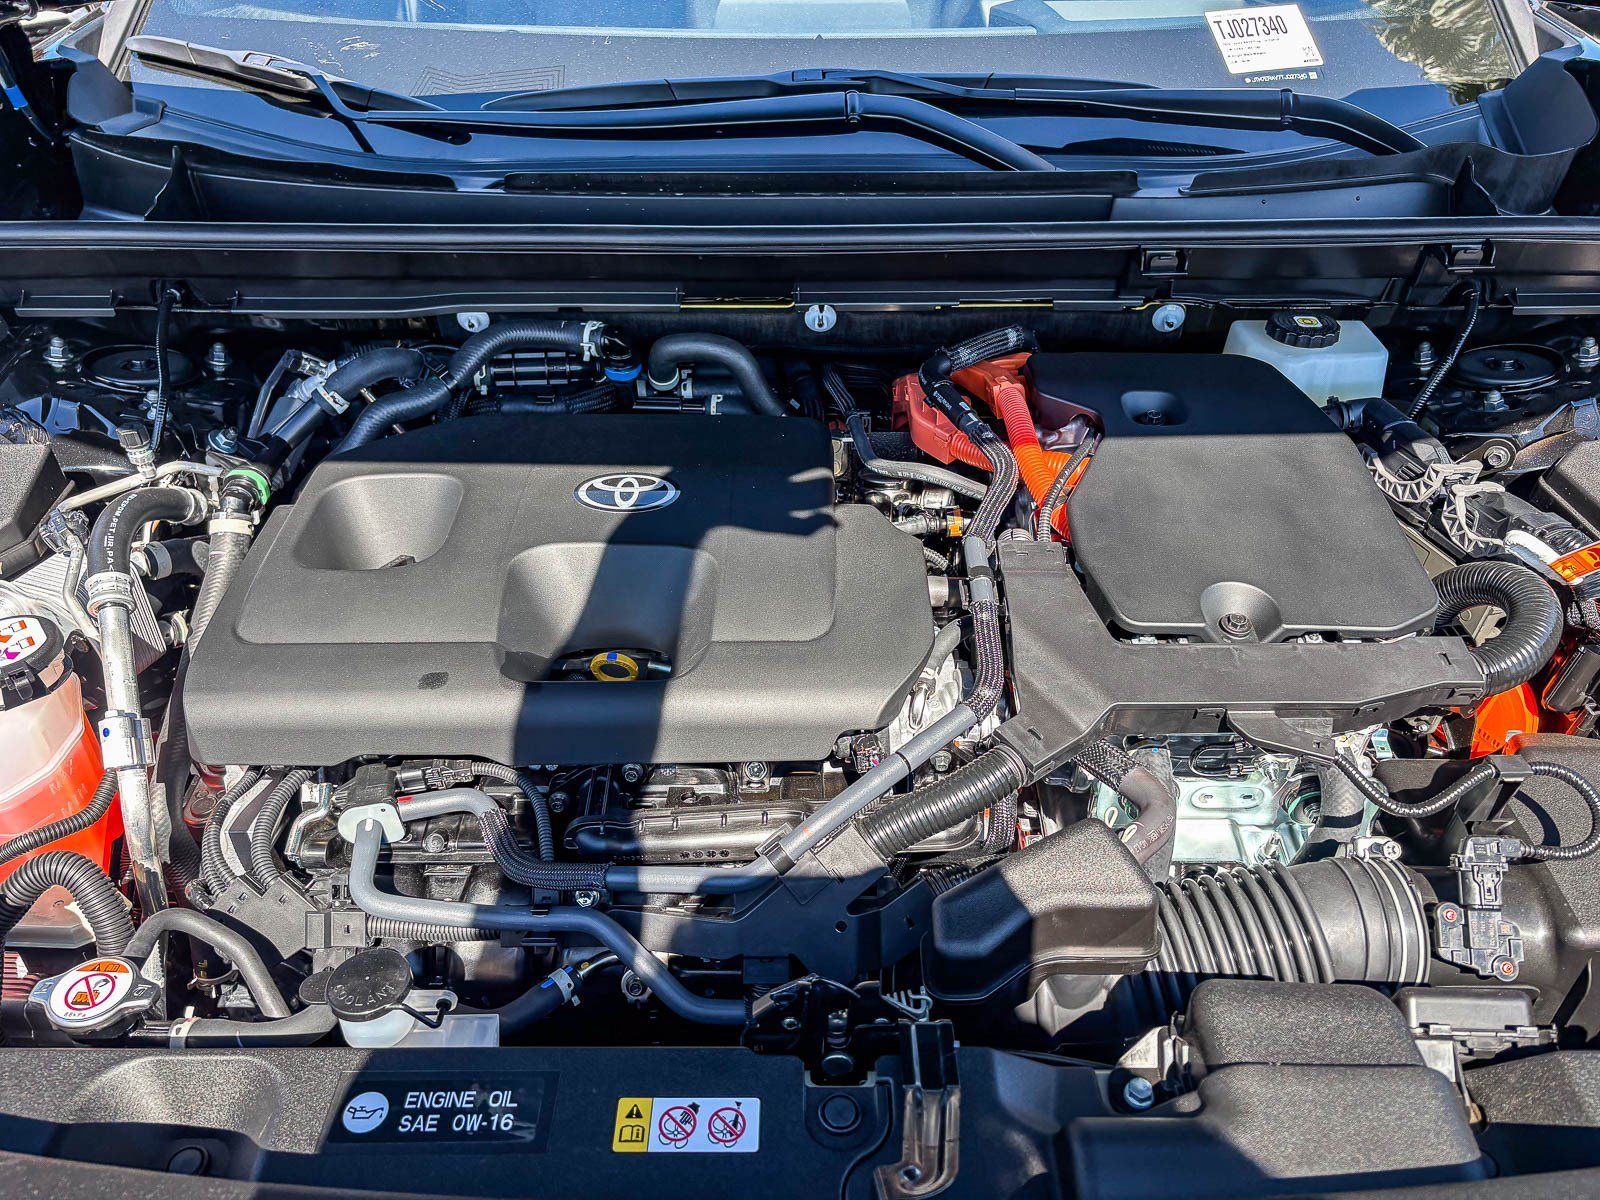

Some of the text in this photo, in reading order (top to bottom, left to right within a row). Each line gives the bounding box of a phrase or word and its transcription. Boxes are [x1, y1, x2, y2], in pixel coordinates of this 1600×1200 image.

[1213, 15, 1288, 40] TJ027340
[334, 984, 395, 1007] COOLANT
[404, 1090, 518, 1109] ENGINE OIL
[398, 1114, 440, 1132] SAE
